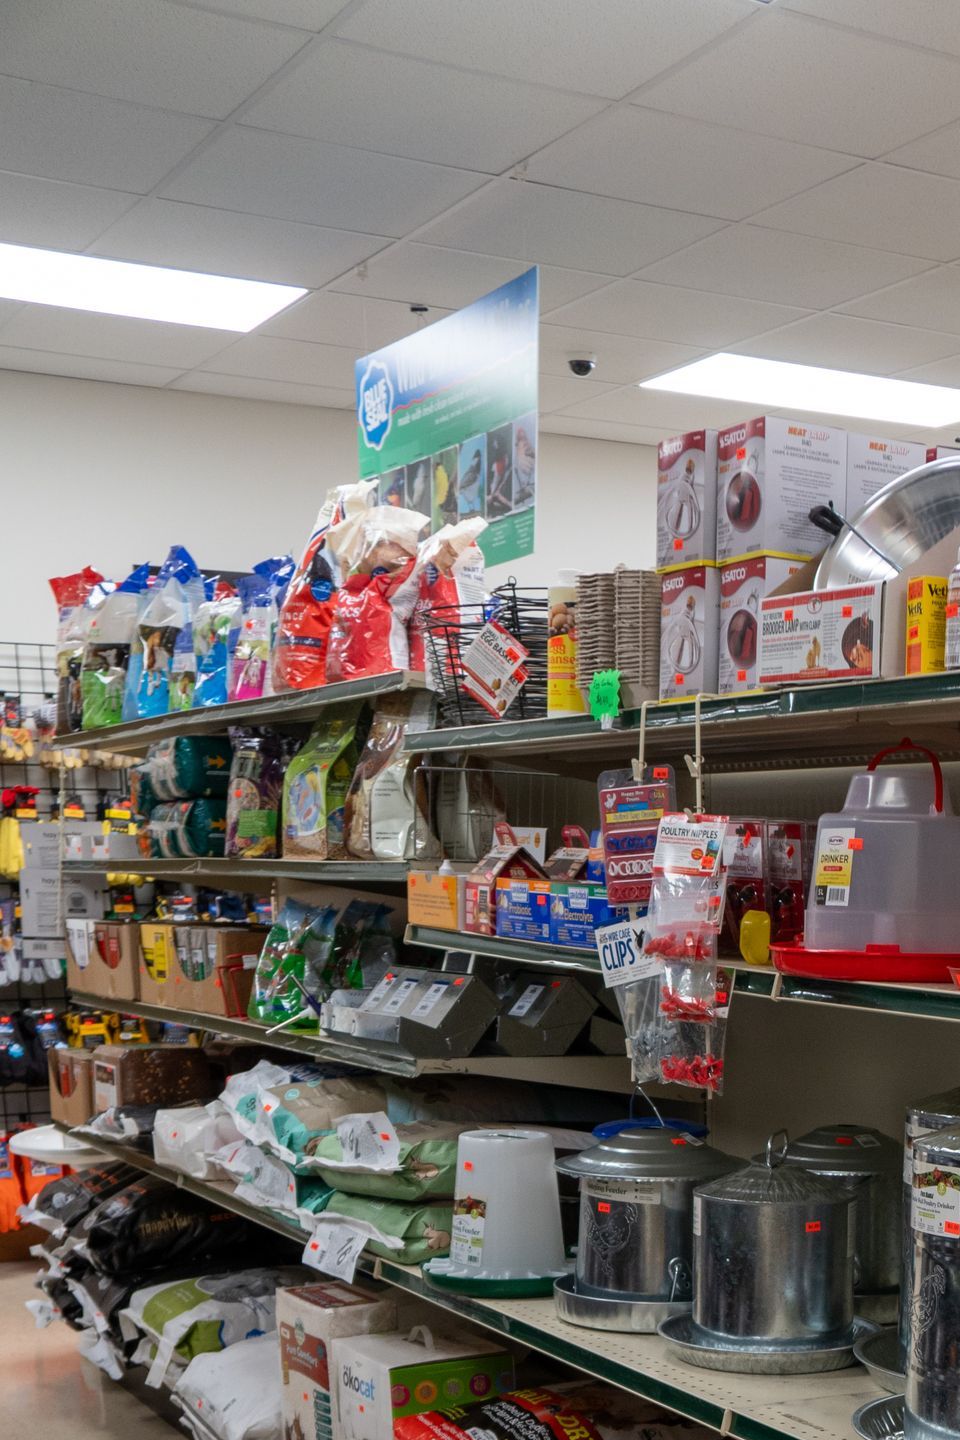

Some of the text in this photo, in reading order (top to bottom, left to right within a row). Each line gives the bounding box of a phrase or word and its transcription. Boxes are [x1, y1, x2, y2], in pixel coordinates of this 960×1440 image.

[364, 376, 388, 412] BLUE
[365, 400, 389, 432] SEAL
[725, 428, 746, 446] SATCO
[788, 426, 808, 438] HEAT
[869, 441, 888, 452] HEAT
[726, 567, 746, 584] SATCO
[667, 576, 685, 591] SATCO
[762, 620, 785, 637] BROODER
[785, 617, 800, 633] LAMP
[809, 619, 821, 631] CLAMP
[480, 632, 494, 647] EGG
[660, 826, 719, 840] POULTRY NIPPLES
[820, 854, 849, 864] DRINKER
[508, 902, 532, 916] Probiotic
[563, 907, 594, 924] Electrolyte
[608, 930, 619, 941] WIRE
[618, 927, 631, 940] CAGE
[602, 937, 636, 971] CLIPS
[605, 1185, 629, 1197] Feeder
[937, 1201, 956, 1211] Drinker
[464, 1226, 481, 1237] Feeder
[343, 1365, 376, 1401] ökocat
